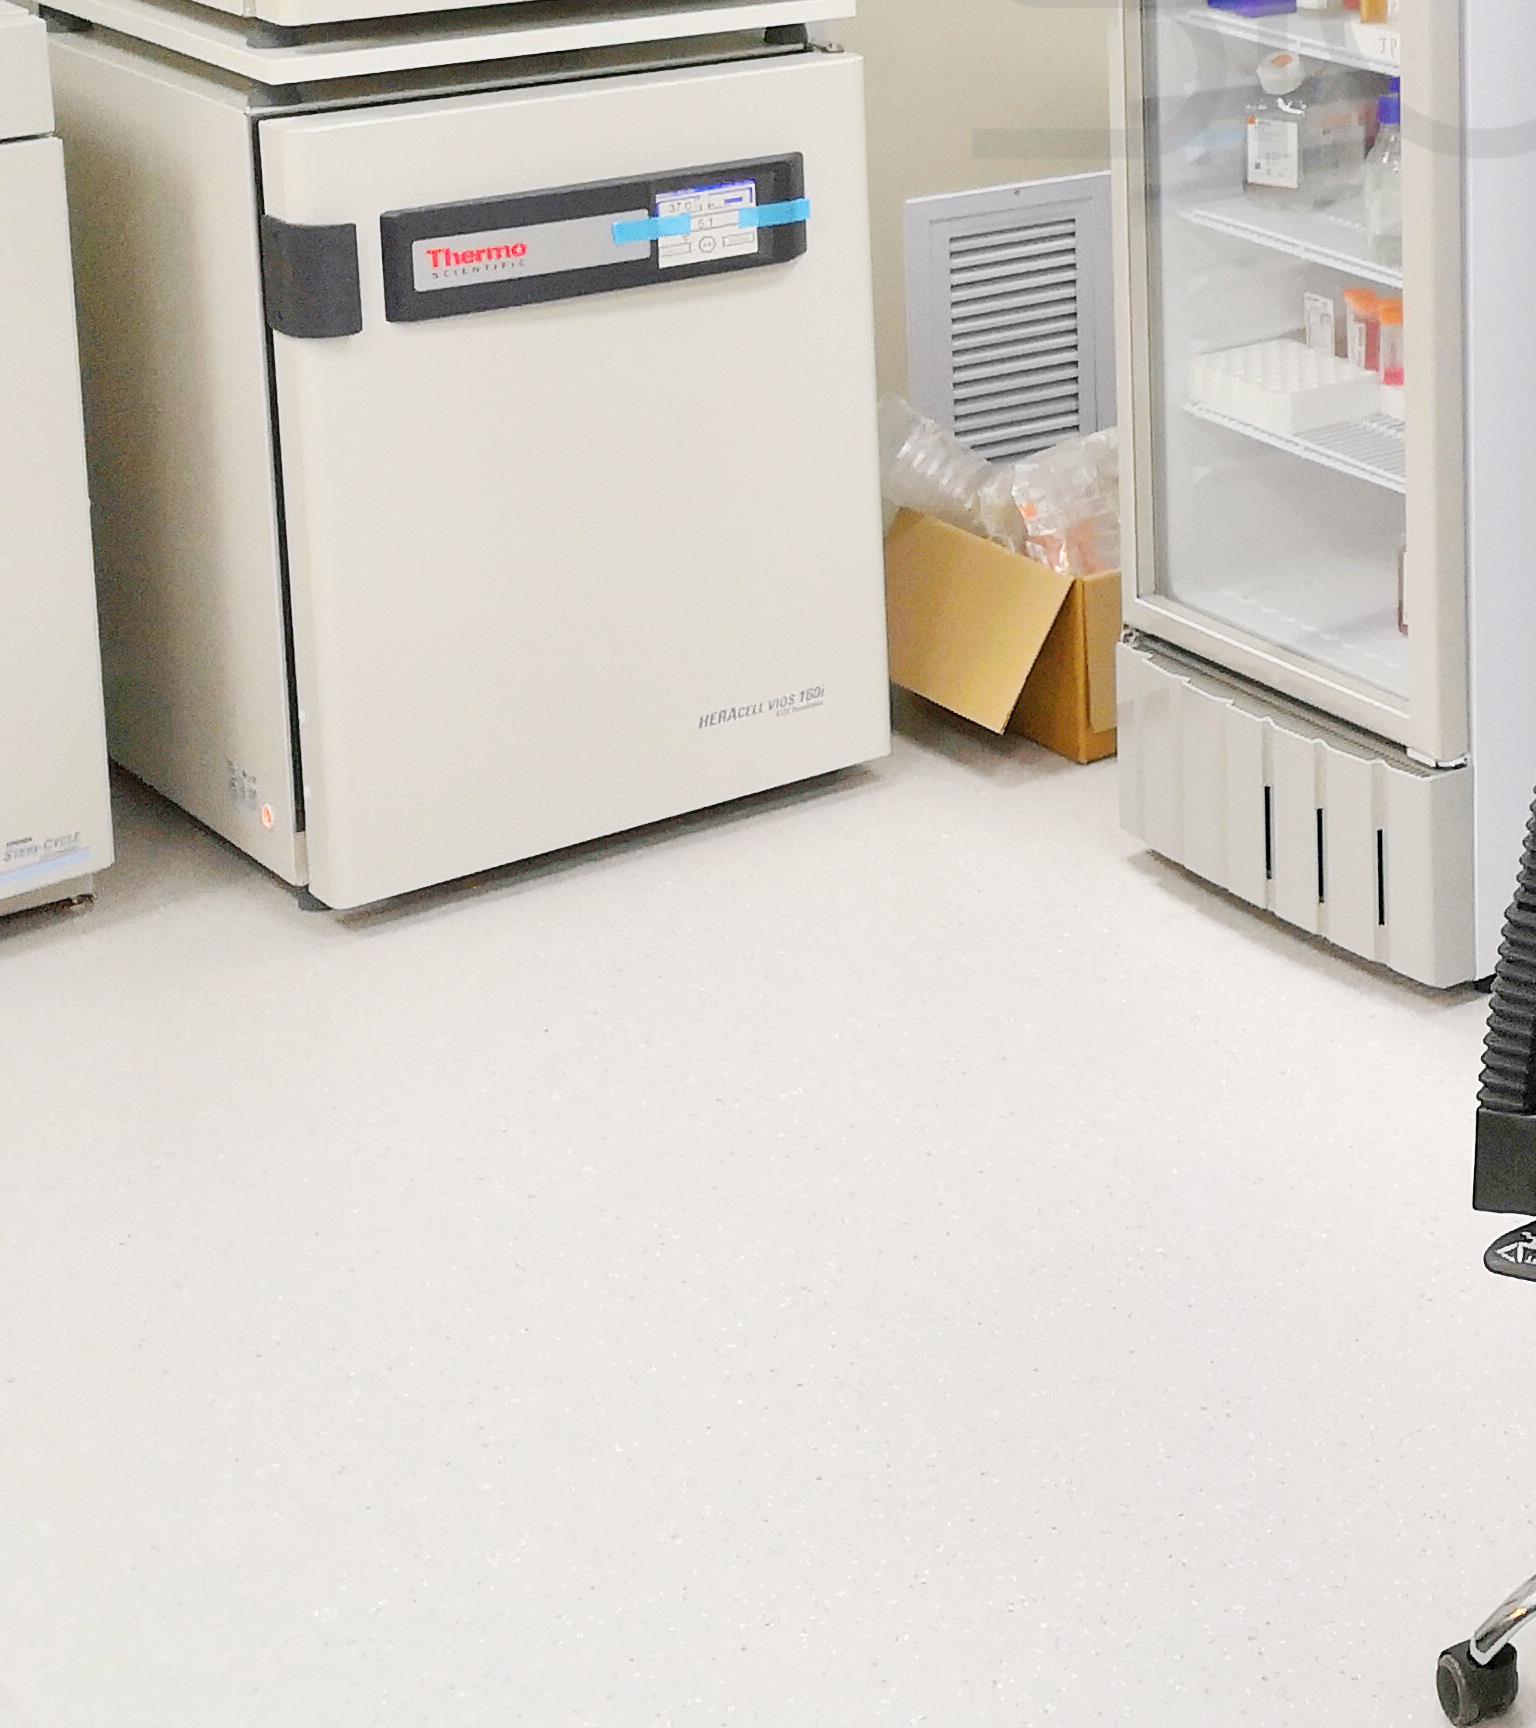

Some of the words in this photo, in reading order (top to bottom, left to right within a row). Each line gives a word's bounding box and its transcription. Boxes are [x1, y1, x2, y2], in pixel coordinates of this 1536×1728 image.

[427, 241, 527, 269] Thermo
[432, 258, 526, 278] SCIENTIFIC
[698, 702, 764, 730] HERACELL
[768, 693, 796, 712] VIOS
